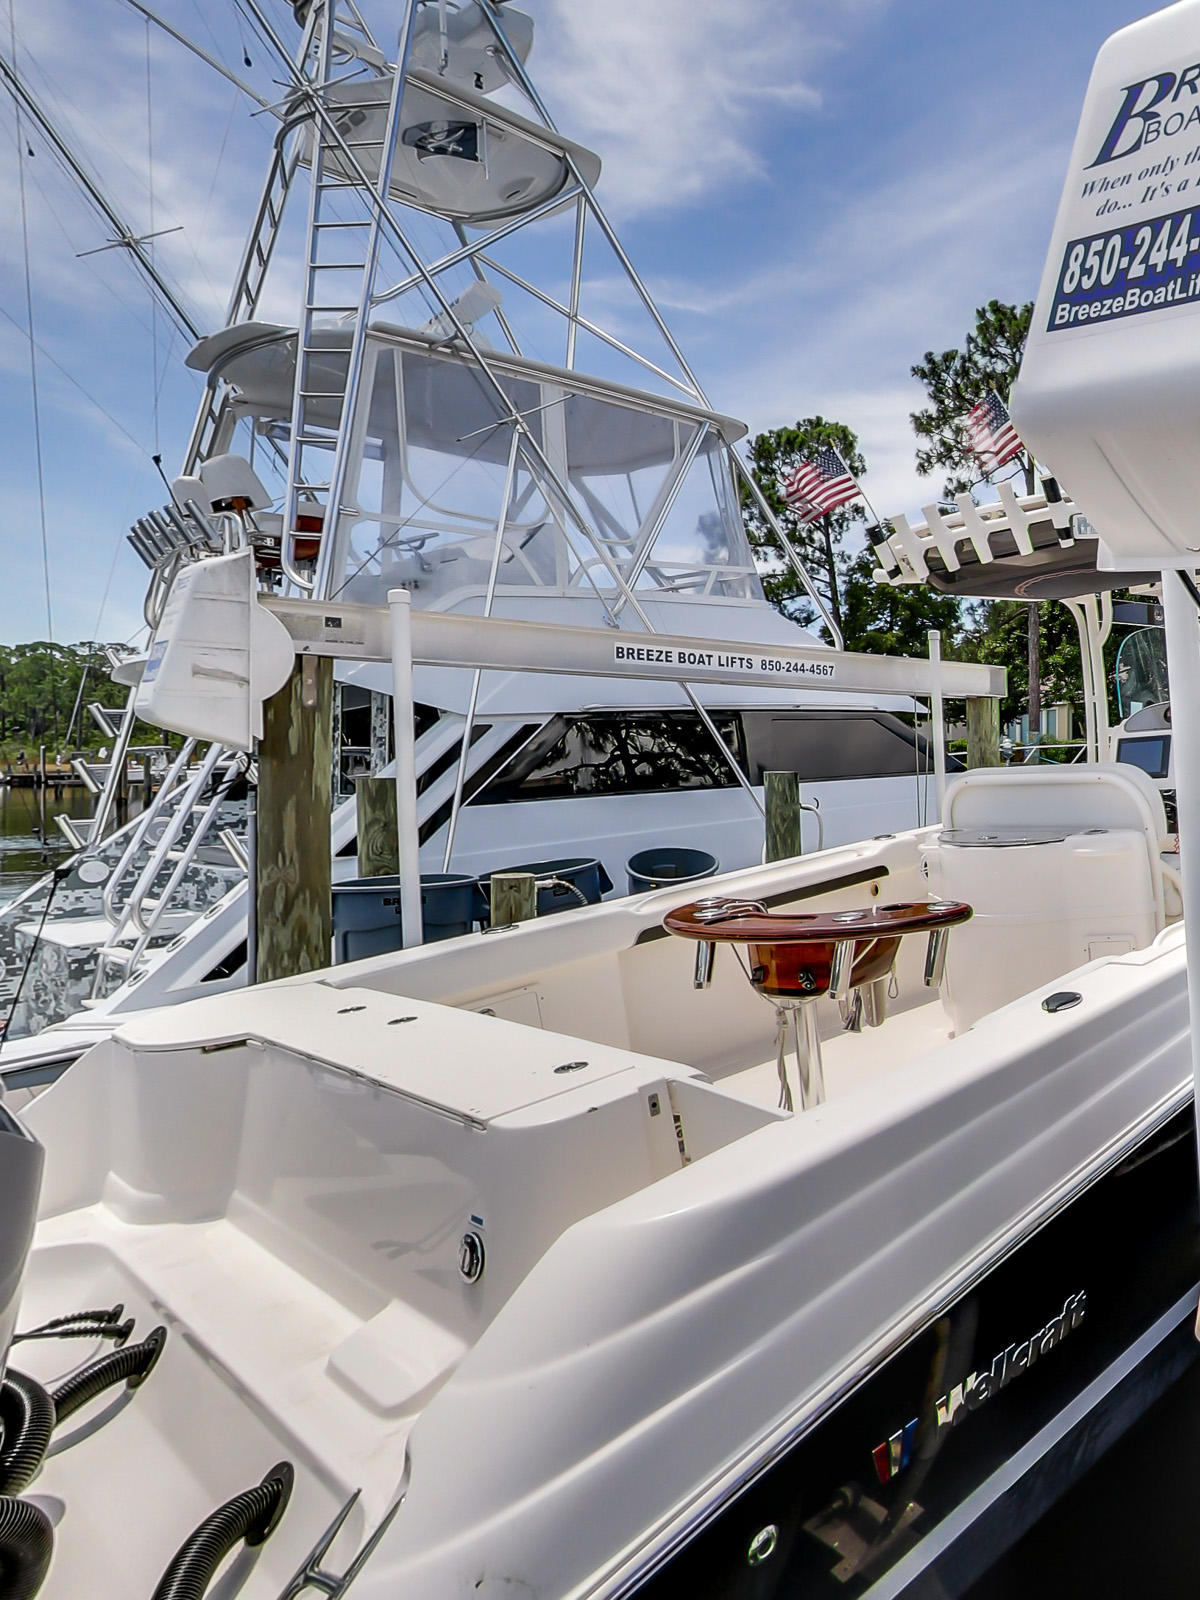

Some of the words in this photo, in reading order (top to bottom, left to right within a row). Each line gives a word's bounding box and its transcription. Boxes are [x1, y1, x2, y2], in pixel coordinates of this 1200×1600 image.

[1081, 171, 1132, 199] When
[1137, 155, 1180, 186] only
[1095, 192, 1133, 218] do...
[1141, 180, 1172, 204] It's
[1176, 181, 1188, 193] a
[615, 646, 673, 663] BREEZE
[677, 652, 714, 667] BOAT
[717, 655, 754, 670] LIFTS
[760, 659, 835, 677] 850-244-4567
[935, 1290, 1087, 1427] Wellcraft
